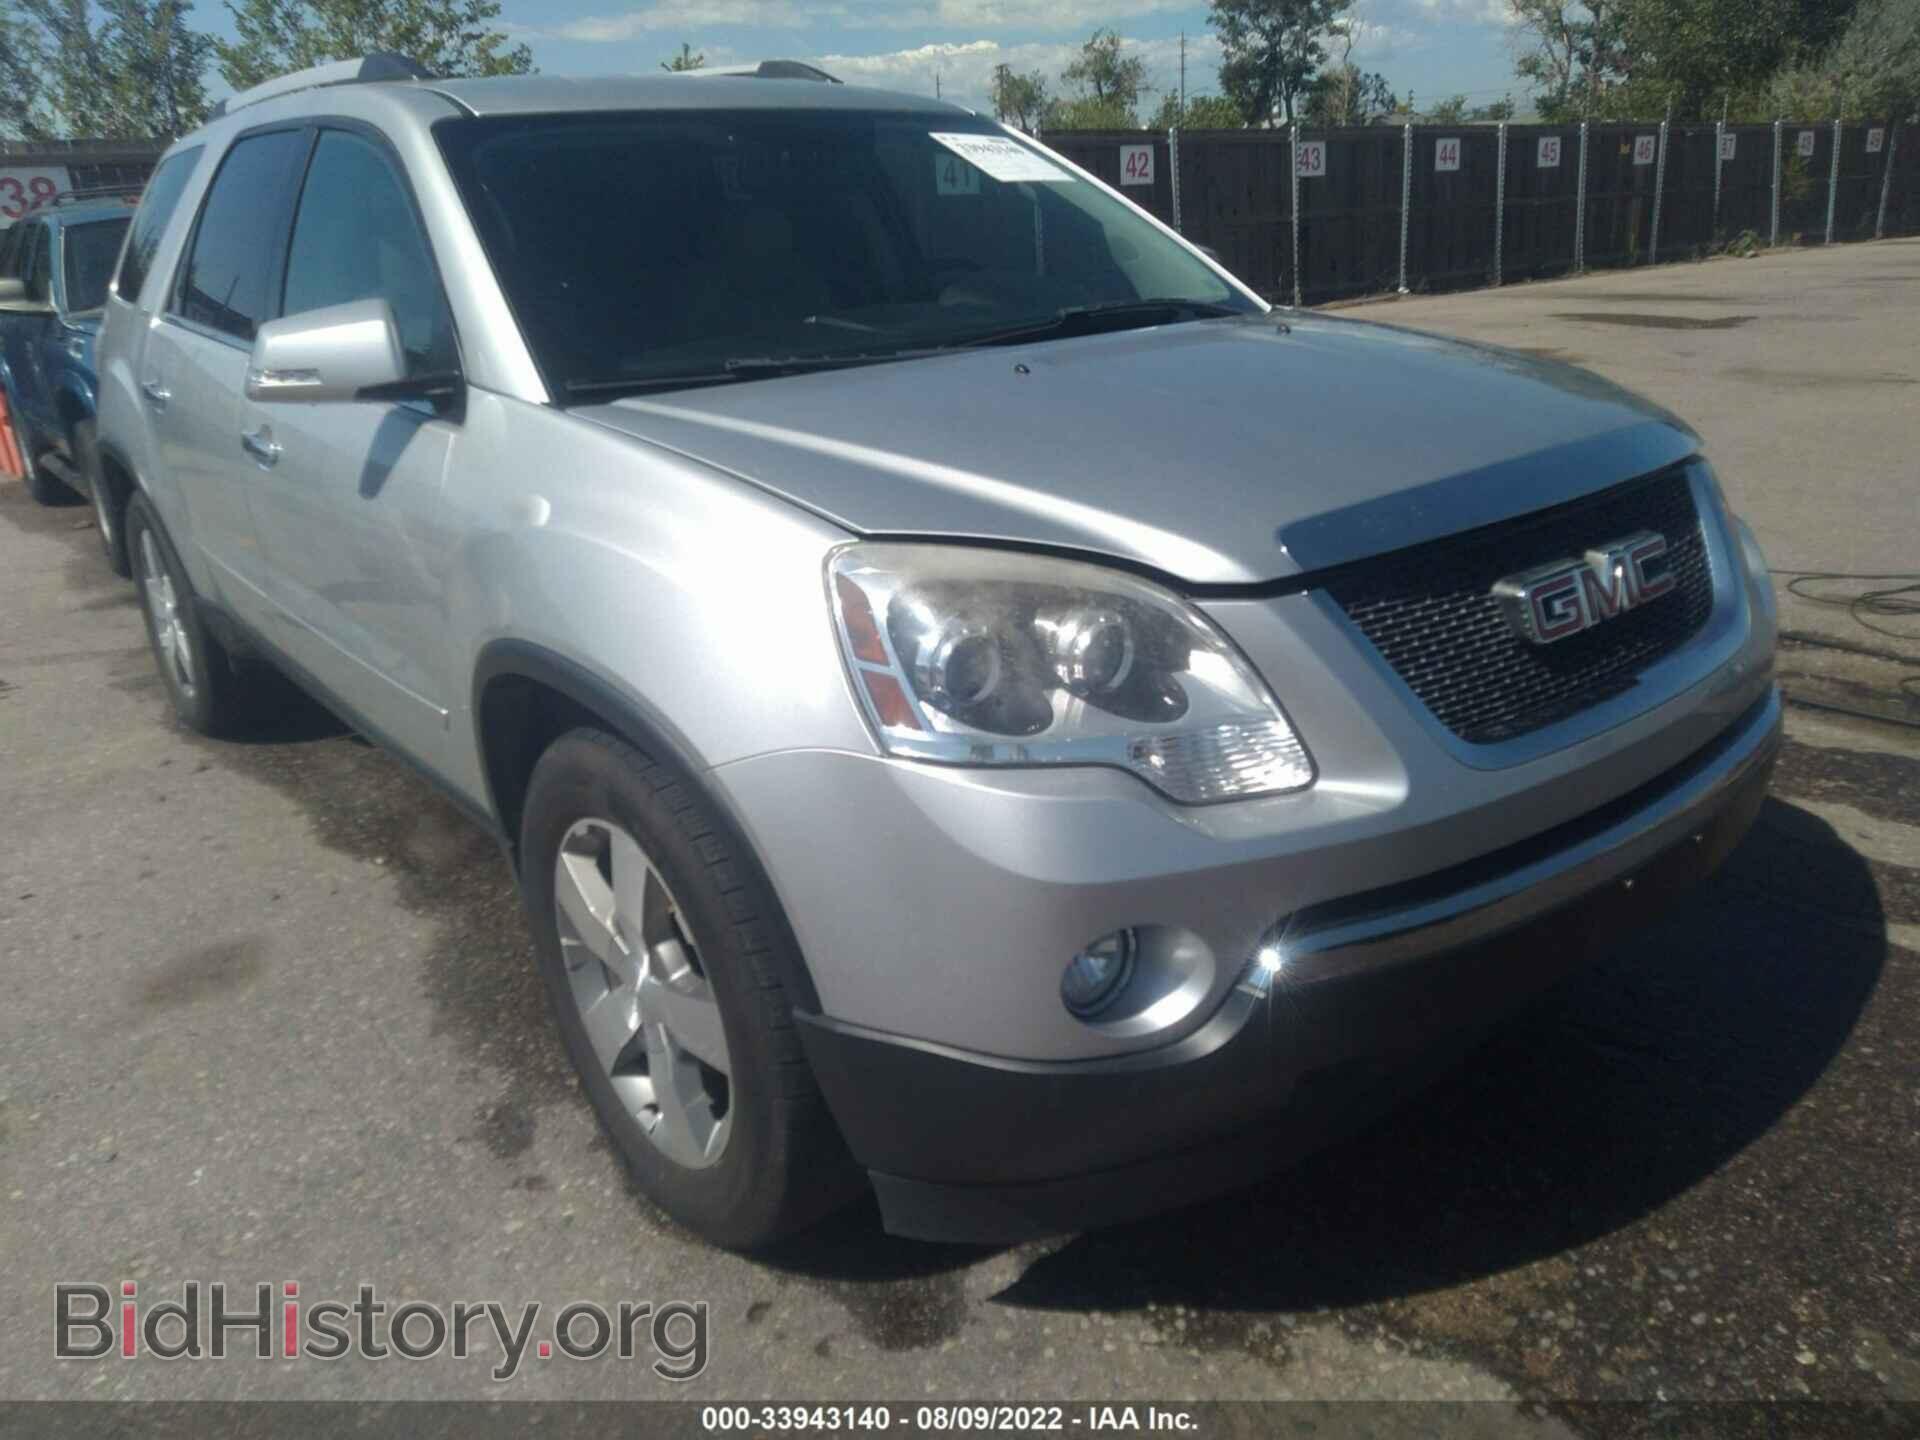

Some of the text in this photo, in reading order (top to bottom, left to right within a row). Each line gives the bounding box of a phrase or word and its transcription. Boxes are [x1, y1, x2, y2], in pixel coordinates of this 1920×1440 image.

[1301, 147, 1321, 171] 43
[1440, 143, 1457, 165] 44
[1541, 141, 1558, 162] 45
[1125, 151, 1149, 178] 42
[1494, 533, 1674, 645] GMC
